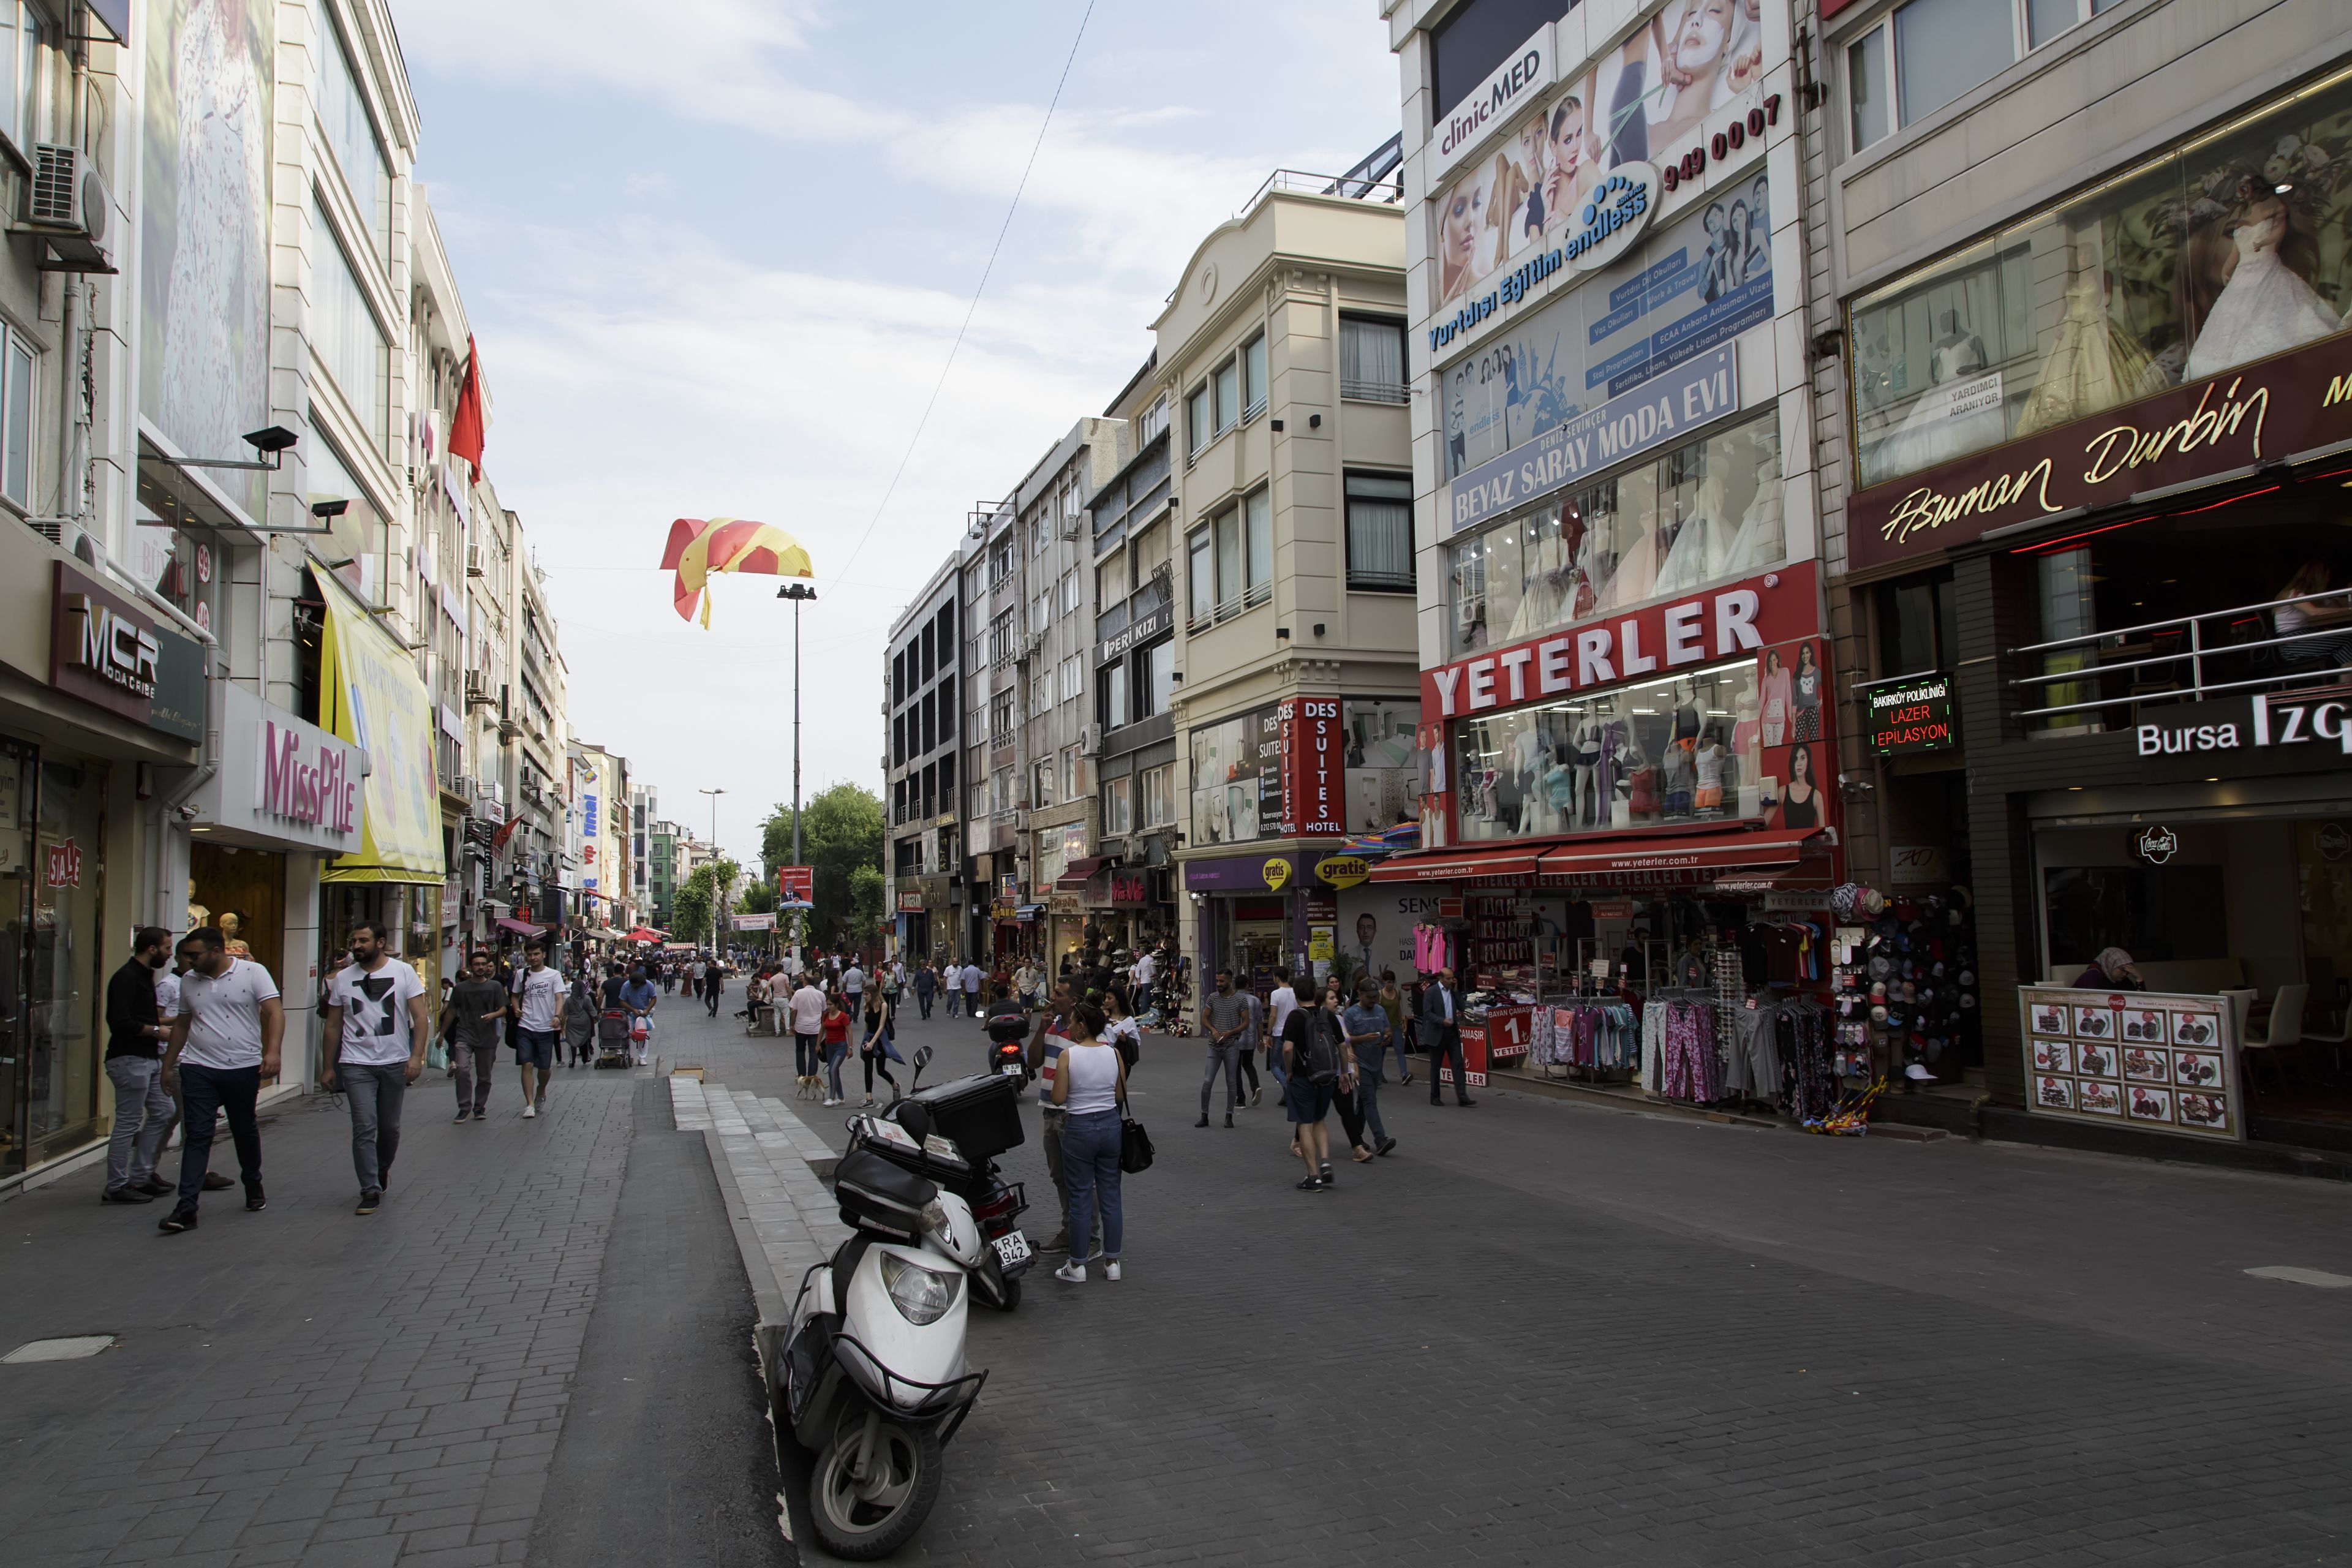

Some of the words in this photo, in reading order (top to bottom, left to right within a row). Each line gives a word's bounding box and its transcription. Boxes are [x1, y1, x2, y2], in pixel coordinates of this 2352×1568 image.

[1664, 147, 1706, 192] 949
[1500, 248, 1561, 305] Eğitim
[1566, 192, 1648, 260] endless
[1647, 290, 1665, 305] Work
[1675, 274, 1697, 292] Travel
[1594, 325, 1607, 337] Yaz
[1607, 309, 1634, 330] Okulları
[1660, 330, 1679, 345] ECAA
[1681, 315, 1708, 334] Ankara
[1749, 277, 1772, 296] Vizesi
[1615, 371, 1644, 391] Sertifika,
[1646, 358, 1668, 375] Lisans,
[1669, 344, 1694, 363] Yüksek
[1696, 331, 1718, 349] Lisans
[1719, 307, 1766, 337] Programları
[1593, 369, 1605, 382] Staj
[1606, 348, 1644, 375] Programları
[1951, 377, 1997, 402] YARDIMCI
[1950, 392, 2001, 417] ARANIYOR.
[1455, 469, 1515, 525] BEYAZ
[1521, 433, 1591, 493] SARAY
[1599, 395, 1675, 461] MODA
[1683, 352, 1729, 421] EVİ
[1540, 430, 1564, 451] DENİZ
[1566, 409, 1607, 439] SEVİNÇER
[2083, 376, 2271, 485] Durbin
[1109, 627, 1131, 657] PERİ
[1135, 616, 1156, 641] KIZI
[1433, 588, 1764, 717] YETERLER
[1873, 690, 1905, 709] BAKIRKÖY
[1906, 683, 1947, 703] POLİKLİNİĞİ
[1278, 703, 1294, 722] DES
[1305, 702, 1336, 718] DES
[1890, 704, 1931, 724] LAZER
[1264, 715, 1278, 733] DES
[1877, 722, 1948, 747] EPİLASYON
[2137, 723, 2241, 756] Bursa
[1316, 720, 1328, 819] SUITES
[584, 794, 597, 837] final
[1262, 811, 1283, 820] Rezervasyon
[1306, 822, 1341, 832] HOTEL
[1280, 823, 1297, 834] HOTEL
[50, 847, 80, 882] SALE
[1265, 863, 1284, 880] gratis
[1323, 860, 1366, 879] gratis
[1417, 867, 1474, 878] www.yeterler.com.tr
[1611, 855, 1699, 869] www.yeterler.com.tr
[1531, 871, 1597, 887] YETERLER
[1606, 869, 1683, 886] YETERLER
[1715, 880, 1774, 891] www.yeterler.com.tr
[1771, 897, 1825, 907] YETERLER
[1488, 1009, 1508, 1018] BAYAN
[1504, 1017, 1520, 1044] 1
[1001, 1234, 1022, 1250] RA
